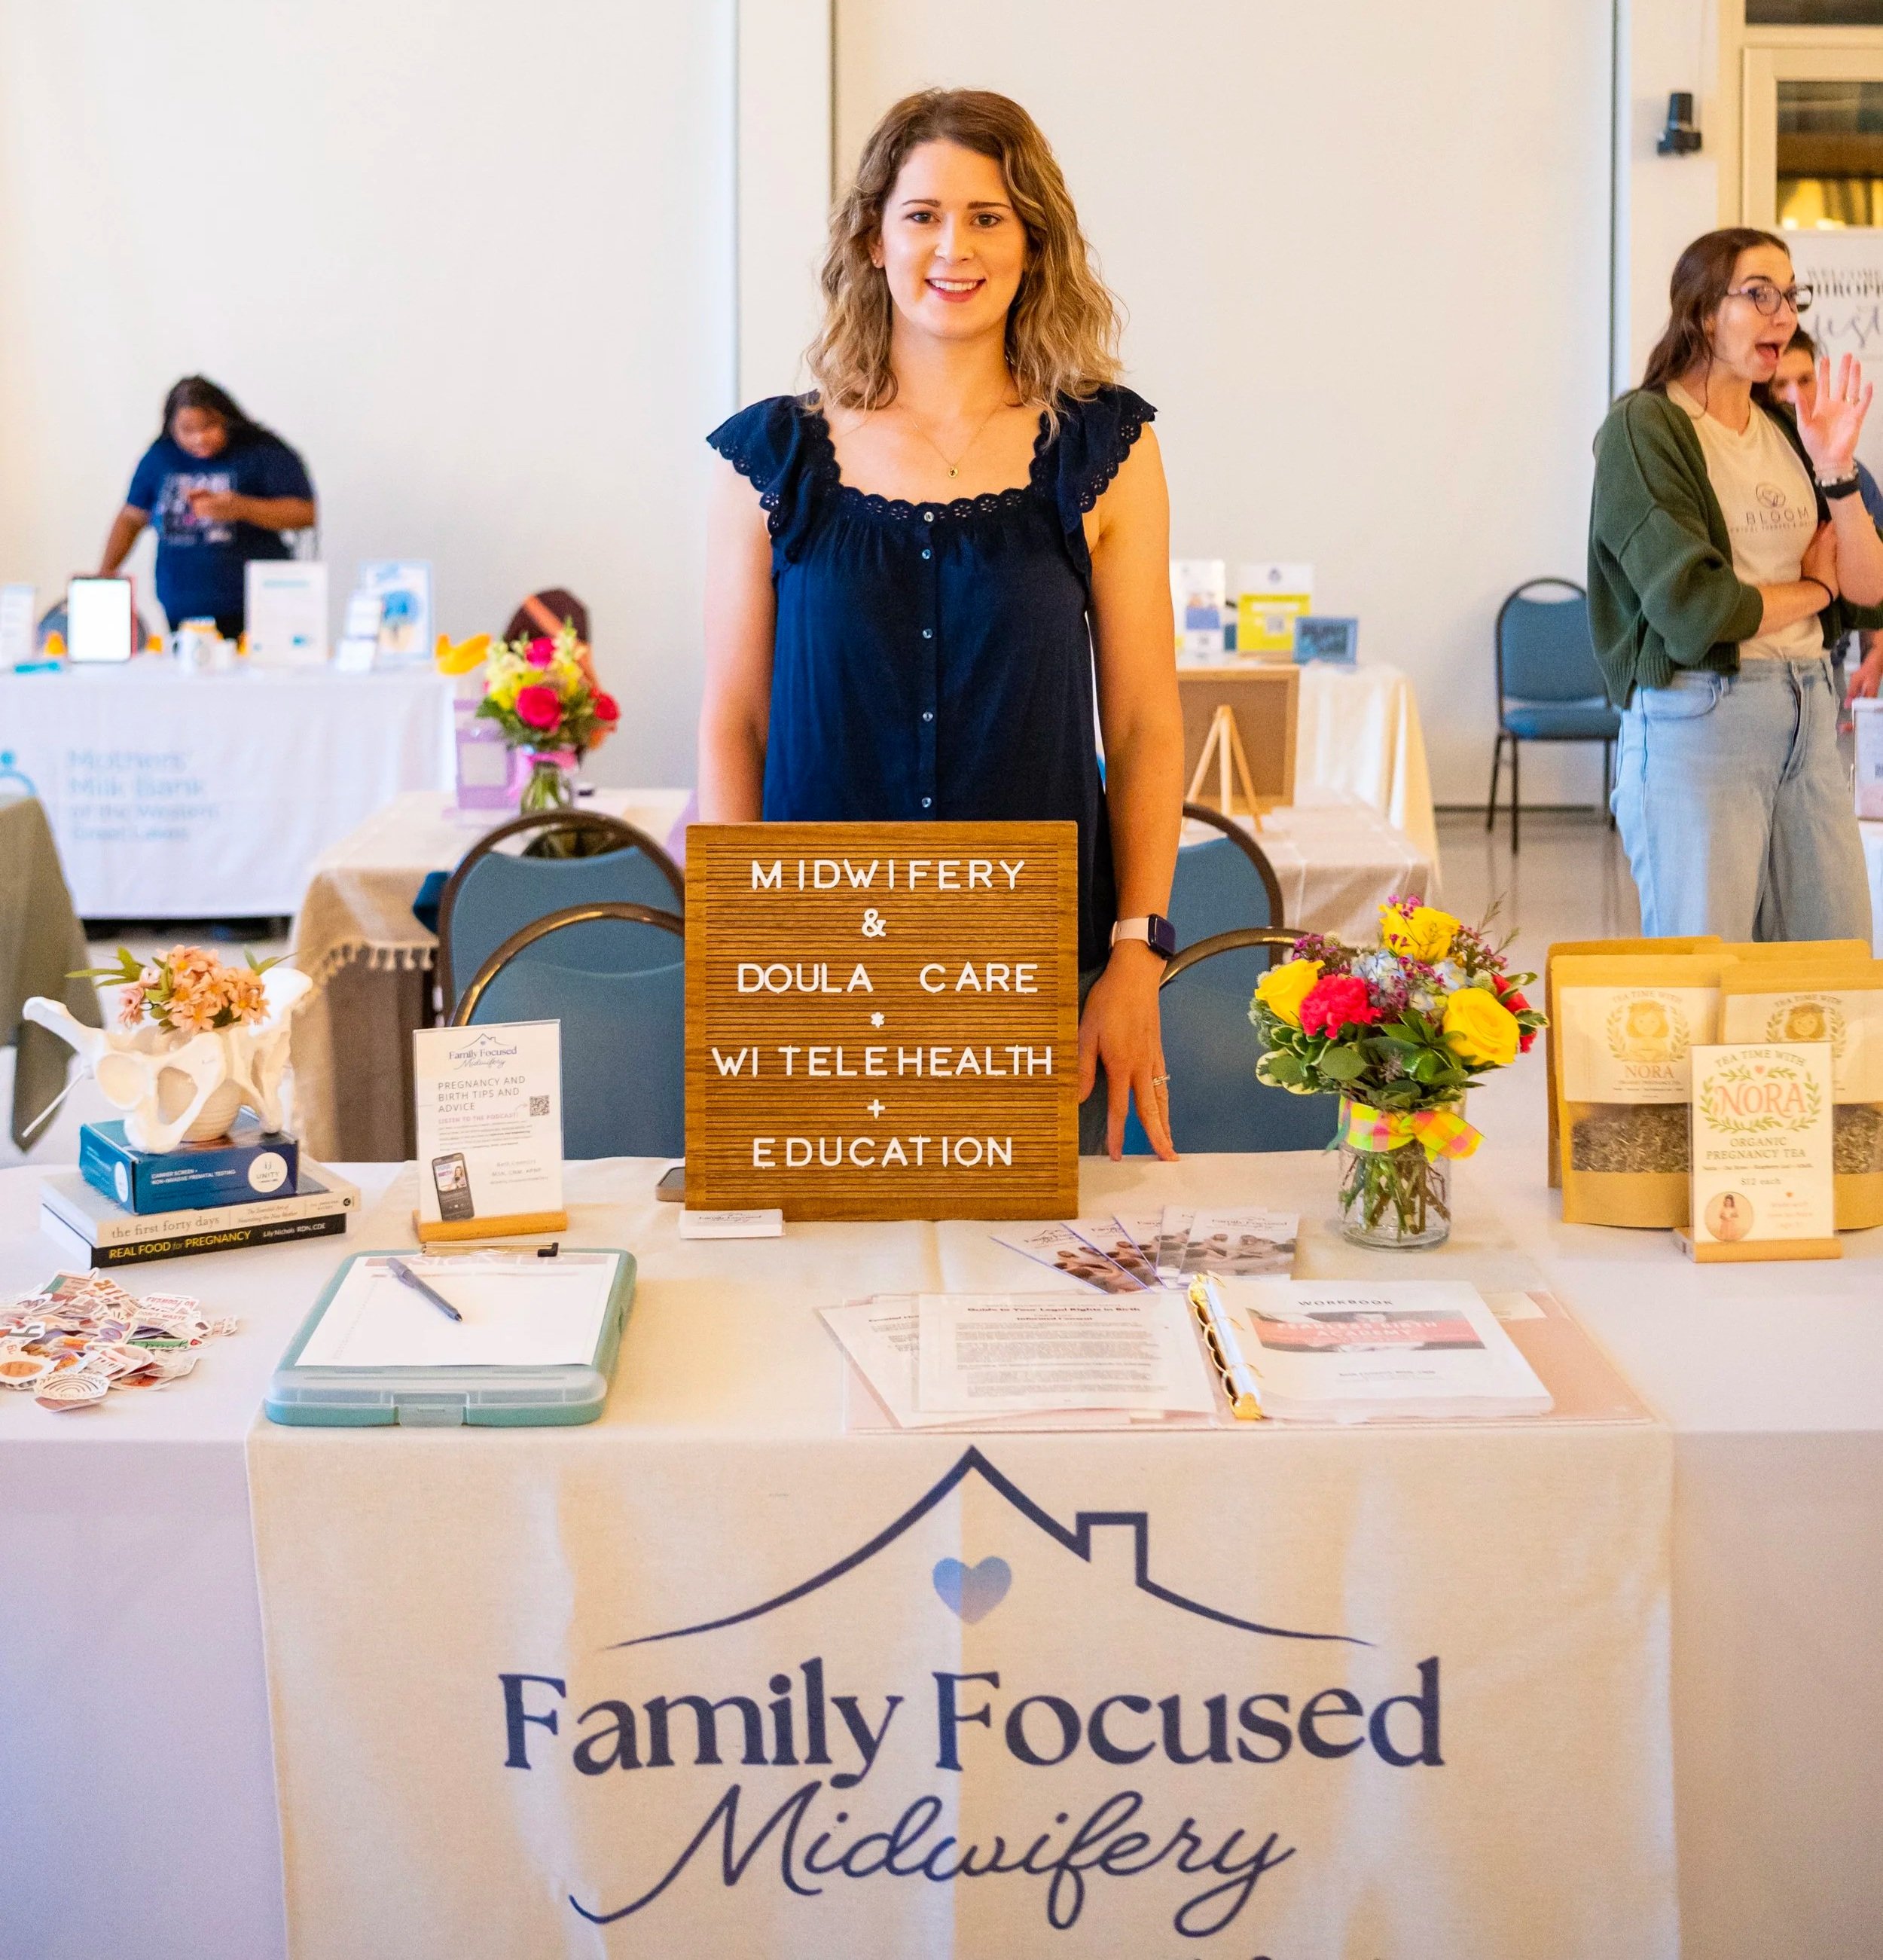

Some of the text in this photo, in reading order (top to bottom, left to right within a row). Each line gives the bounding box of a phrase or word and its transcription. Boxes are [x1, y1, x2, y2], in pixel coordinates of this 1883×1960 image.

[1745, 506, 1809, 525] BLOOM
[752, 859, 1025, 890] MIDWIFERY
[861, 908, 887, 938] &
[737, 962, 1038, 994] DOULA CARE
[450, 1046, 517, 1060] Family Focused
[712, 1045, 1051, 1078] WI TELEHEALTH
[1741, 1049, 1772, 1060] TIME
[1625, 1064, 1675, 1079] NORA
[438, 1075, 526, 1091] PREGNANCY AND
[438, 1087, 520, 1102] BIRTH TIPS AND
[1713, 1082, 1808, 1119] NORA
[438, 1102, 475, 1113] ADVICE
[753, 1134, 1012, 1168] EDUCATION
[1729, 1137, 1787, 1147] ORGANIC
[1706, 1149, 1805, 1160] PREGNANCY TEA
[256, 1171, 280, 1180] UNITY
[1760, 1177, 1782, 1186] each
[111, 1216, 220, 1239] the first forty days
[109, 1230, 252, 1259] REAL FOOD for PREGNANCY
[498, 1656, 1445, 1788] Family Focused
[569, 1779, 1297, 1938] Midwifery
